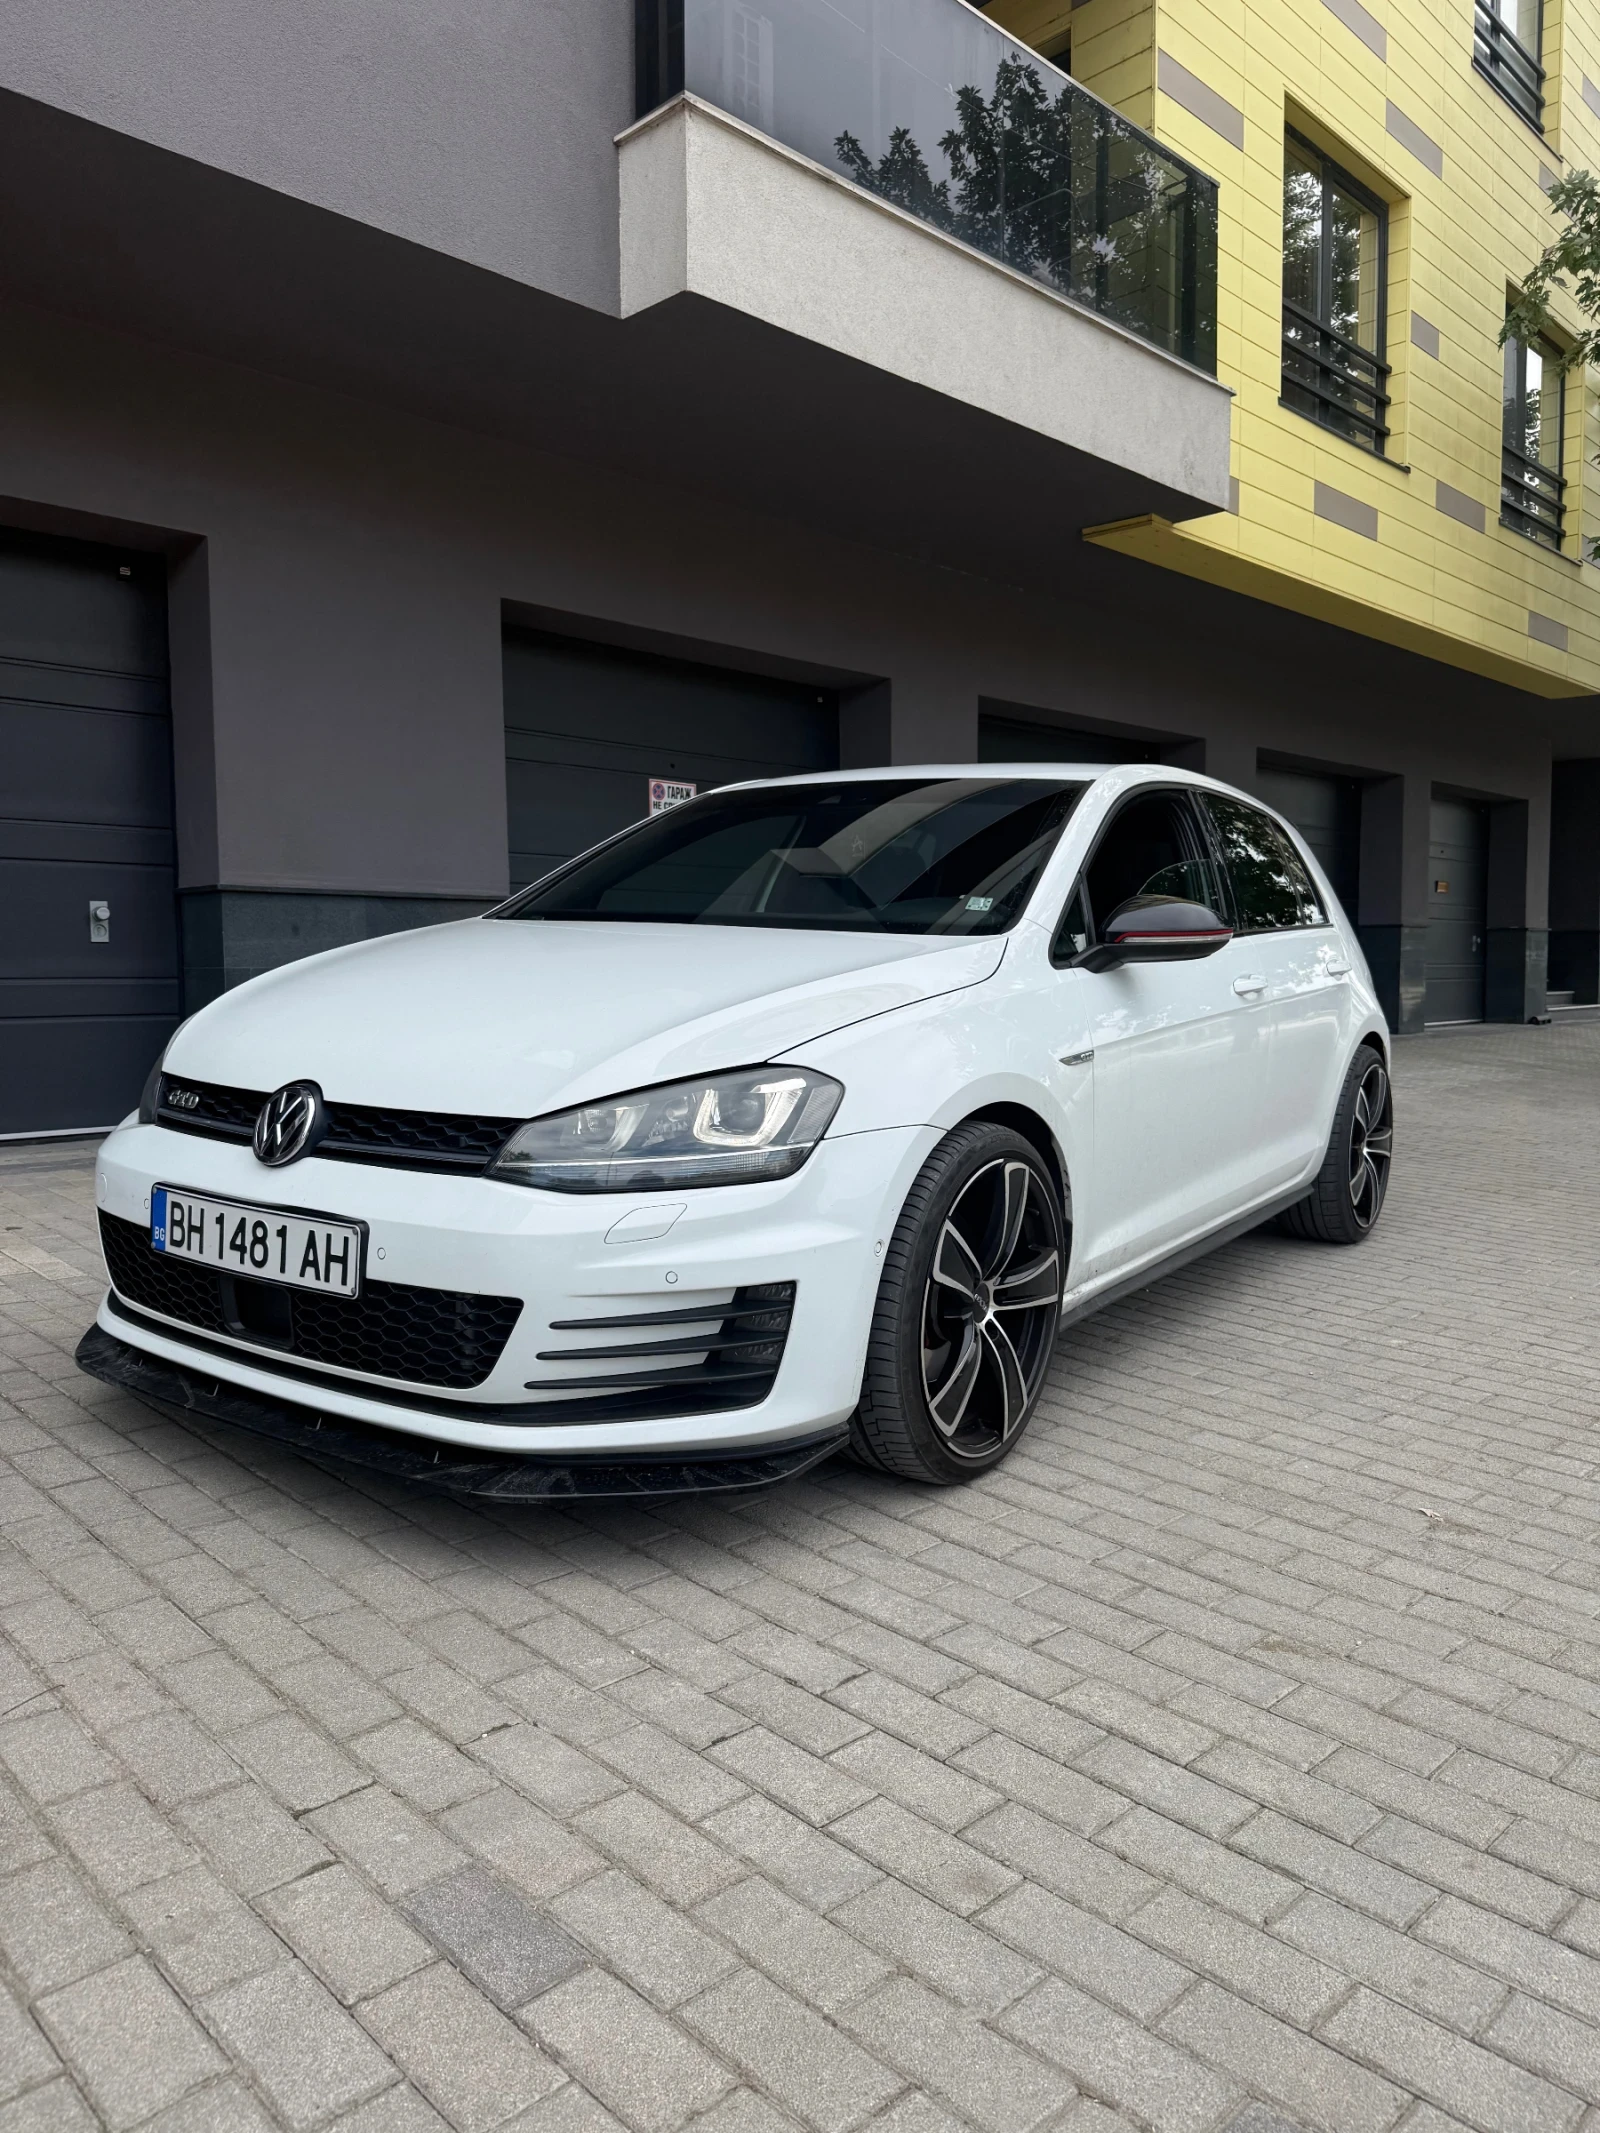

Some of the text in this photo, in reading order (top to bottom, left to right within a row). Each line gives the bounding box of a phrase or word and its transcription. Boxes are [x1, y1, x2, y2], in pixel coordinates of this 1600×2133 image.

[667, 786, 692, 800] ГАРАЖ
[653, 800, 662, 810] НЕ
[154, 1226, 165, 1242] BG
[169, 1200, 350, 1287] BH 1481 AH
